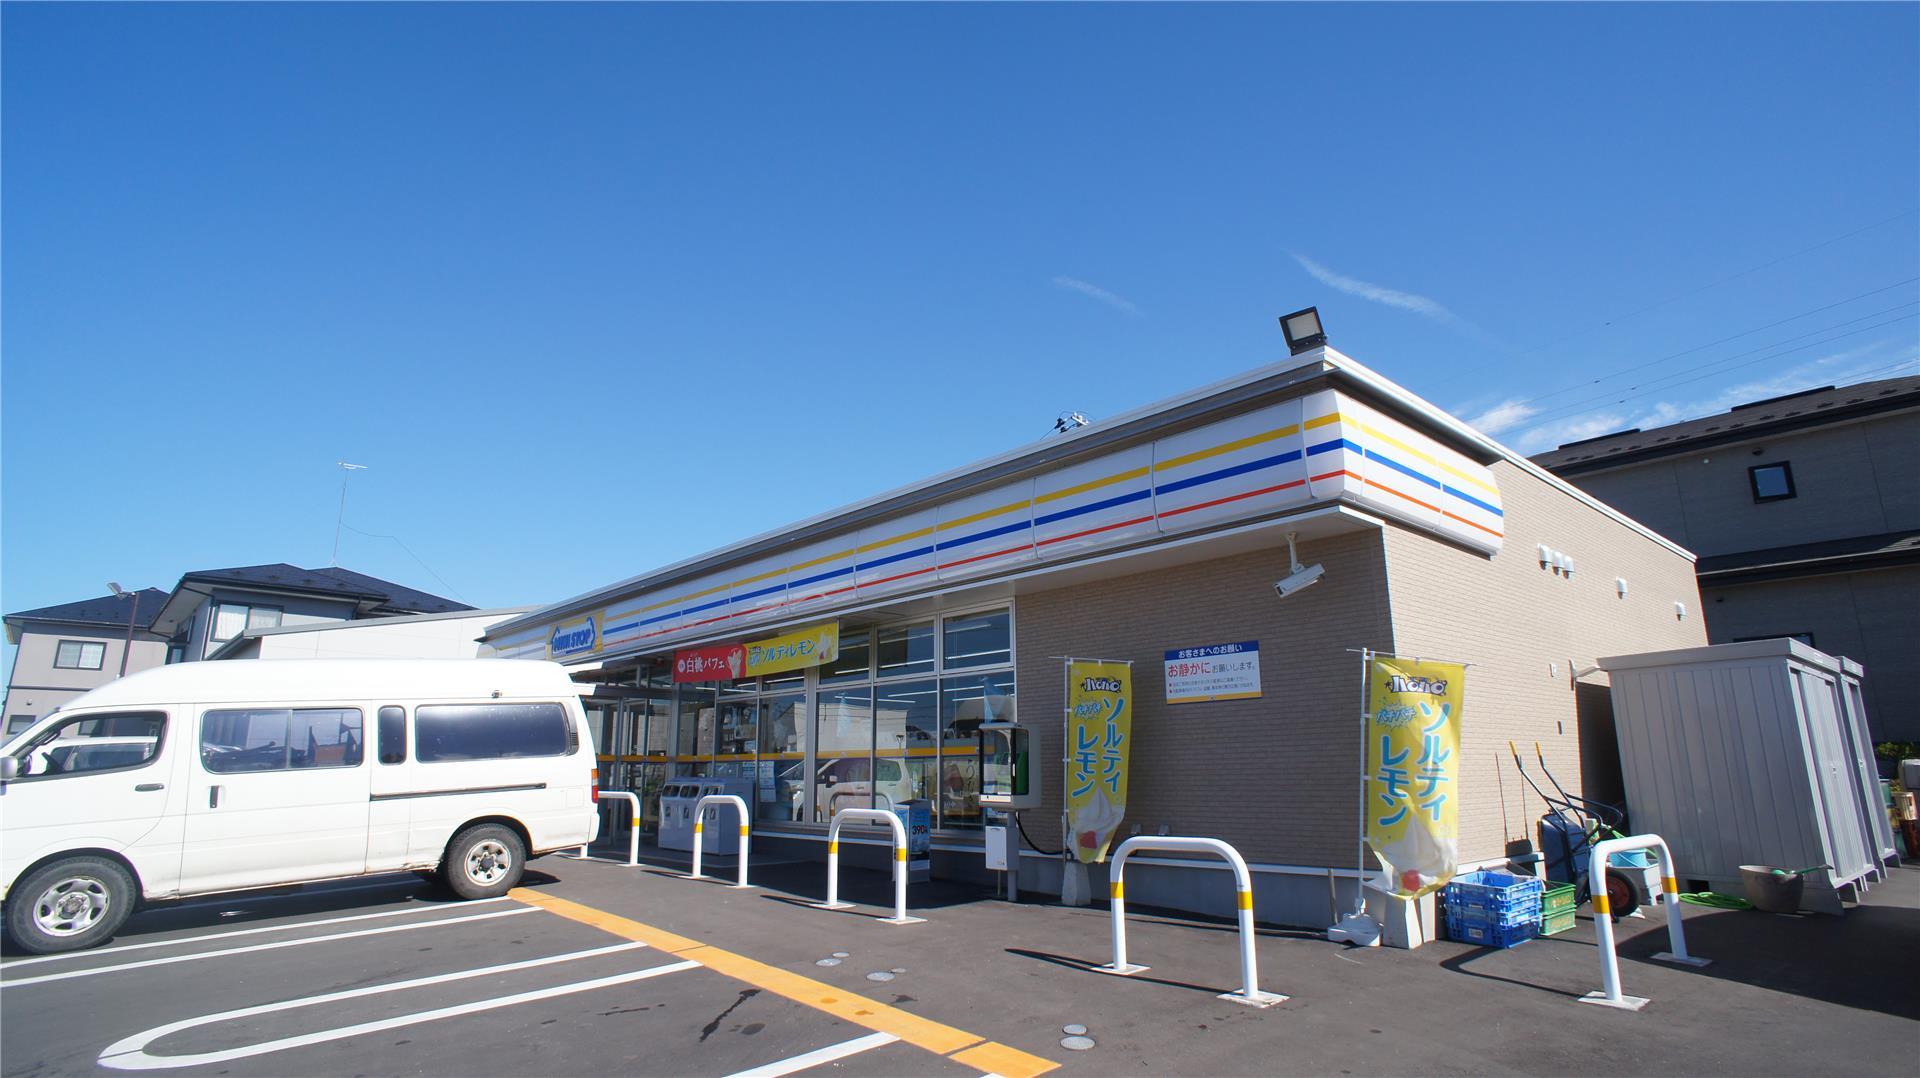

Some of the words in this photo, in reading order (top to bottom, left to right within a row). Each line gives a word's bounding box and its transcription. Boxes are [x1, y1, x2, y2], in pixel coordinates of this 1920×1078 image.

[571, 629, 591, 648] STOP
[763, 639, 816, 664] ソルティレモン
[1178, 643, 1243, 659] お客さまへのお願い
[687, 655, 725, 673] 白桃パフェ
